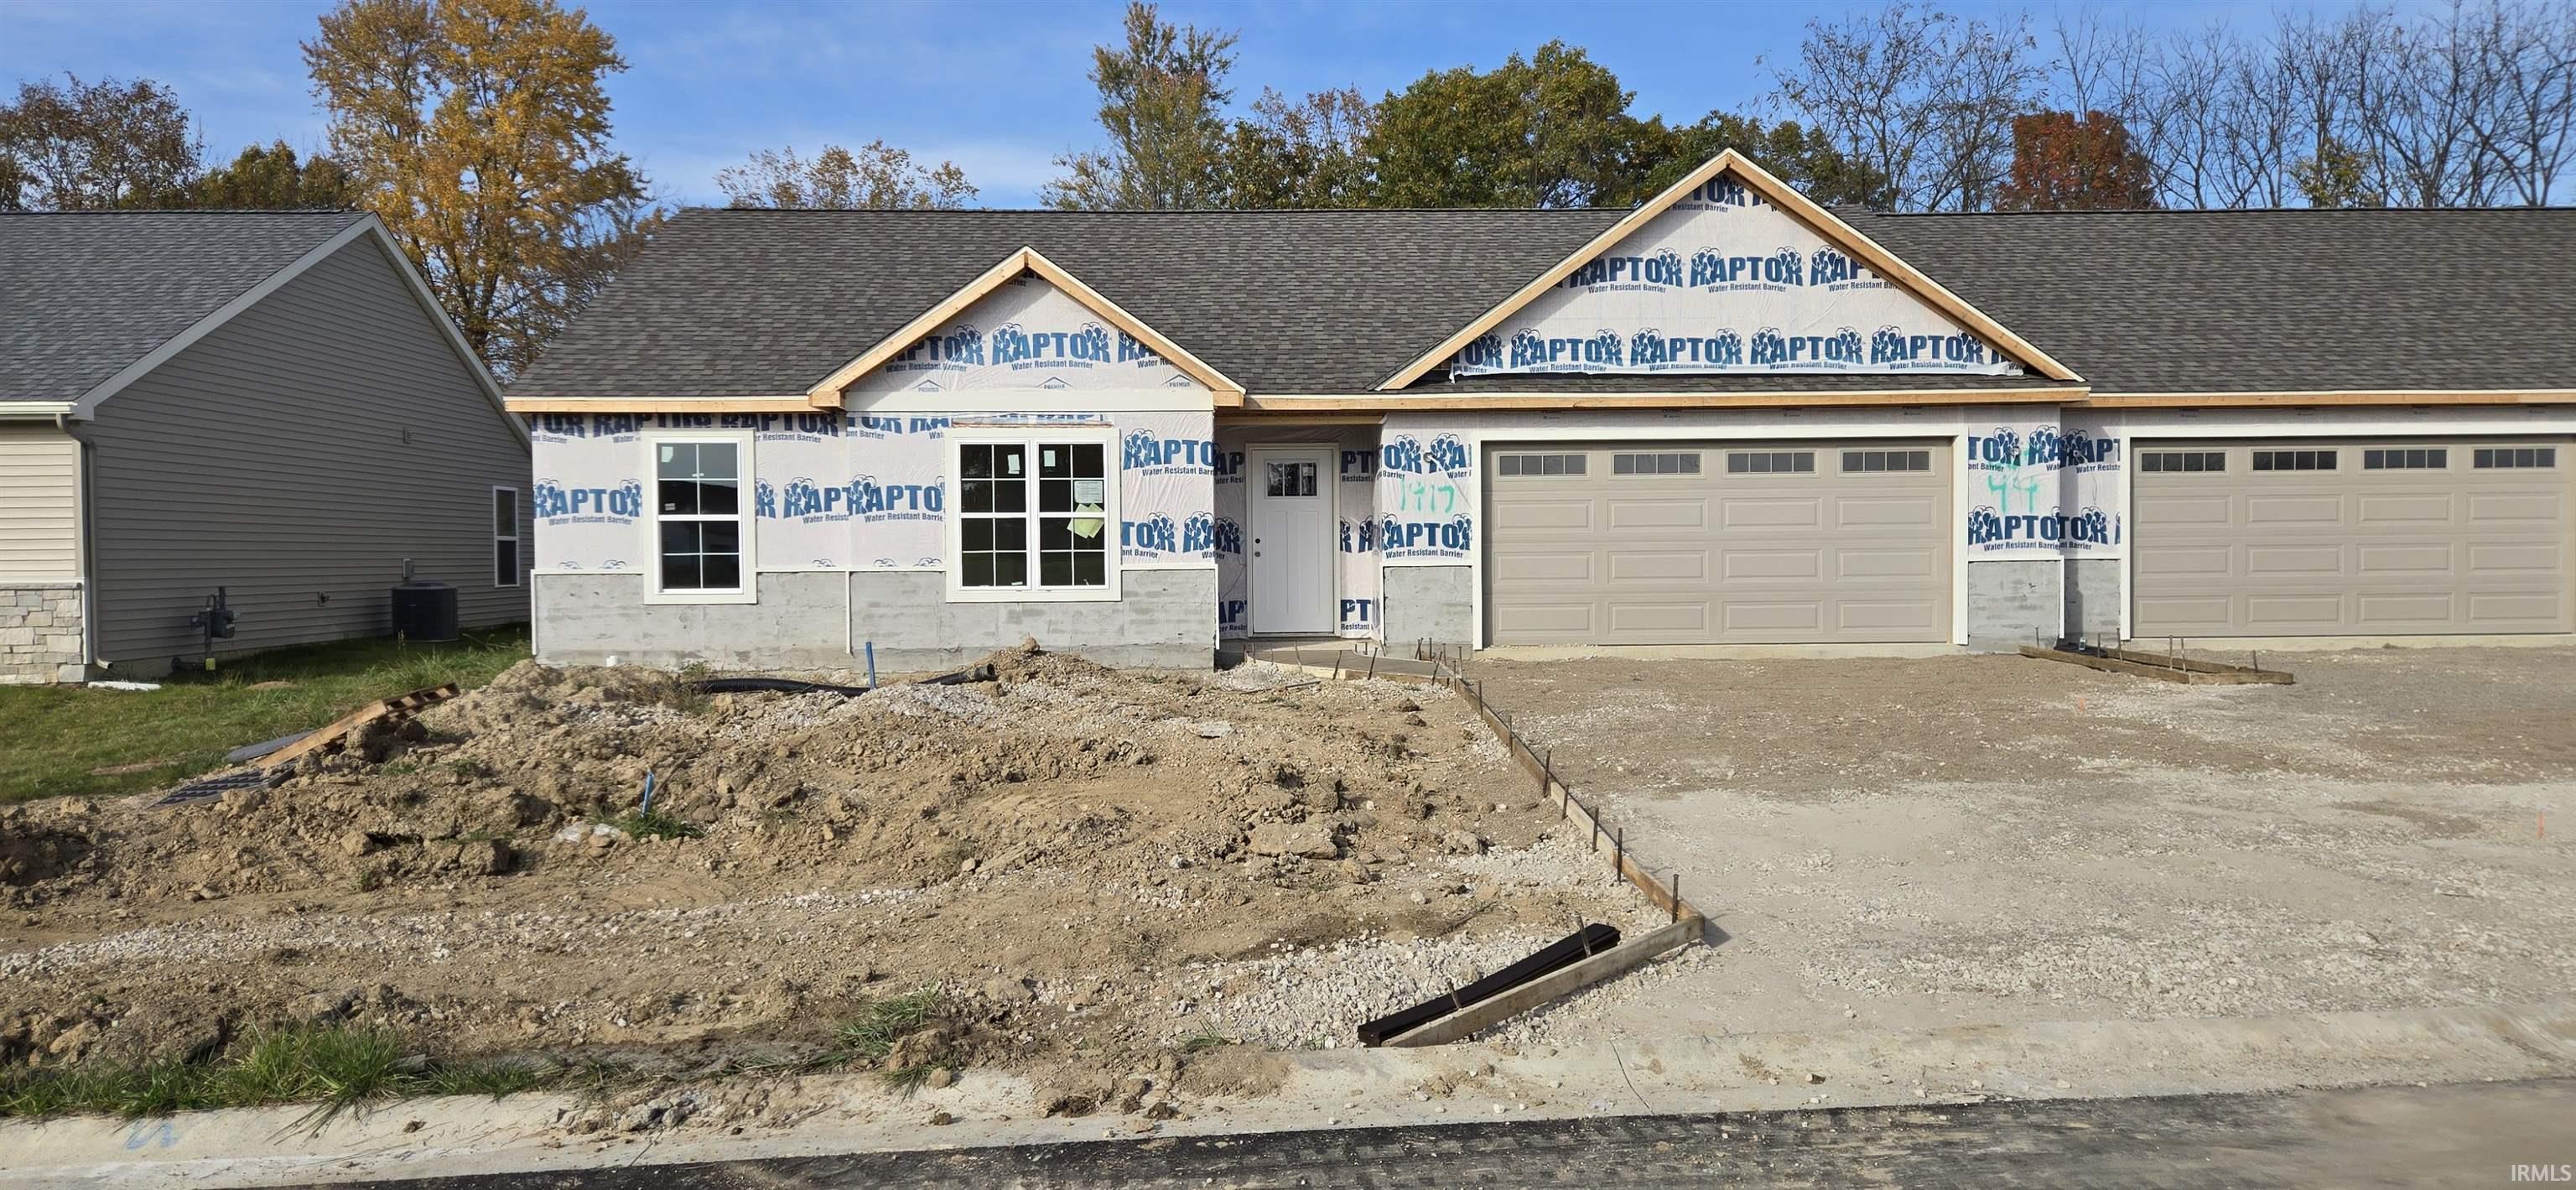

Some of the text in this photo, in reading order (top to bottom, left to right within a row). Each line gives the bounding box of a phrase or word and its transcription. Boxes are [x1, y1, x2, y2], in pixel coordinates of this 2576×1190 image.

[1673, 203, 1728, 212] Resistant Barrier
[1570, 252, 1683, 288] RAPTOR
[1690, 252, 1803, 288] RAPTOR
[1810, 251, 1880, 286] RAP
[1763, 283, 1786, 292] Barrier
[1829, 283, 1849, 292] Water
[992, 328, 1111, 366] RAPTOR
[1510, 333, 1623, 369] RAPTOR
[1630, 333, 1742, 366] RAPTOR
[1750, 332, 1863, 365] RAPTOR
[1871, 330, 1984, 365] RAPTOR
[1011, 360, 1093, 370] Water Resistant Barrier
[1137, 360, 1157, 368] Water
[1583, 363, 1607, 372] Barrier
[1824, 361, 1847, 370] Barrier
[1944, 361, 1967, 370] Barrier
[1463, 366, 1488, 374] Barrier
[797, 434, 821, 443] Barrier
[860, 430, 885, 439] Barrier
[1142, 468, 1162, 476] Water
[1383, 470, 1406, 480] Barrier
[1447, 470, 1467, 479] Water
[607, 516, 632, 525] Barrier
[2069, 542, 2092, 550] Barrier
[1135, 549, 1158, 558] Barrier
[1385, 550, 1405, 559] Water
[1441, 549, 1463, 558] Barrier
